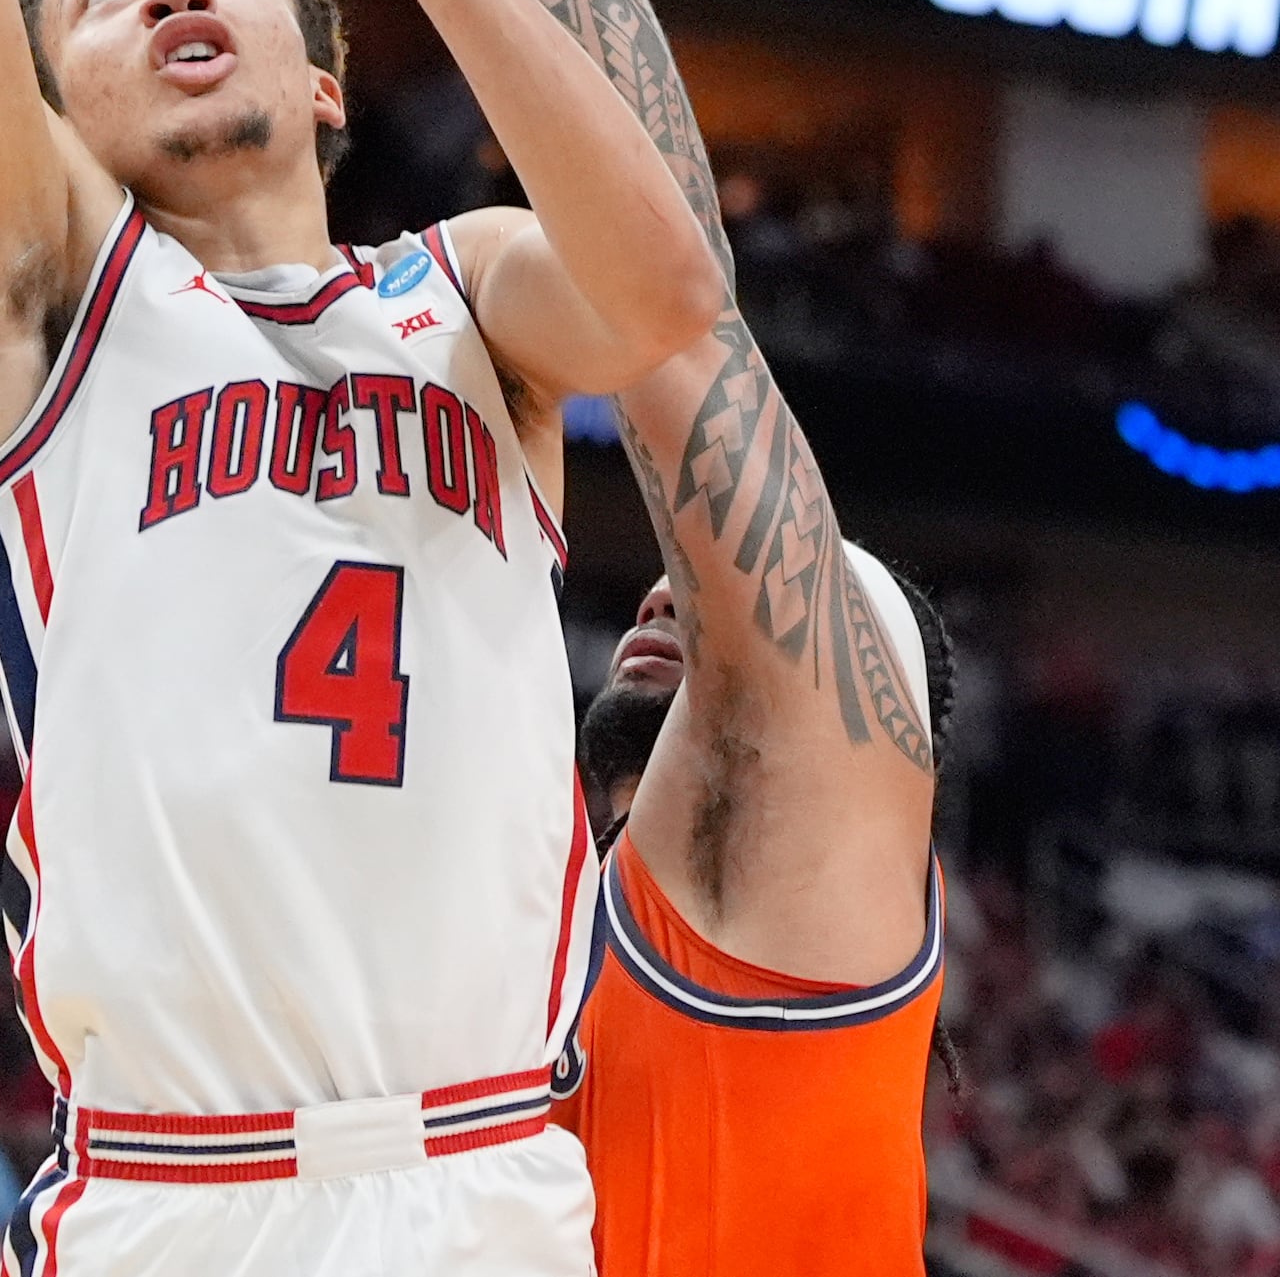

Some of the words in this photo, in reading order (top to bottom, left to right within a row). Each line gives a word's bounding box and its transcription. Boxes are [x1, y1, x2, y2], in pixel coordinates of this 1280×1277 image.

[385, 254, 429, 294] NCAA
[391, 308, 443, 340] XII
[138, 372, 508, 563] HOUSTON
[273, 559, 410, 789] 4
